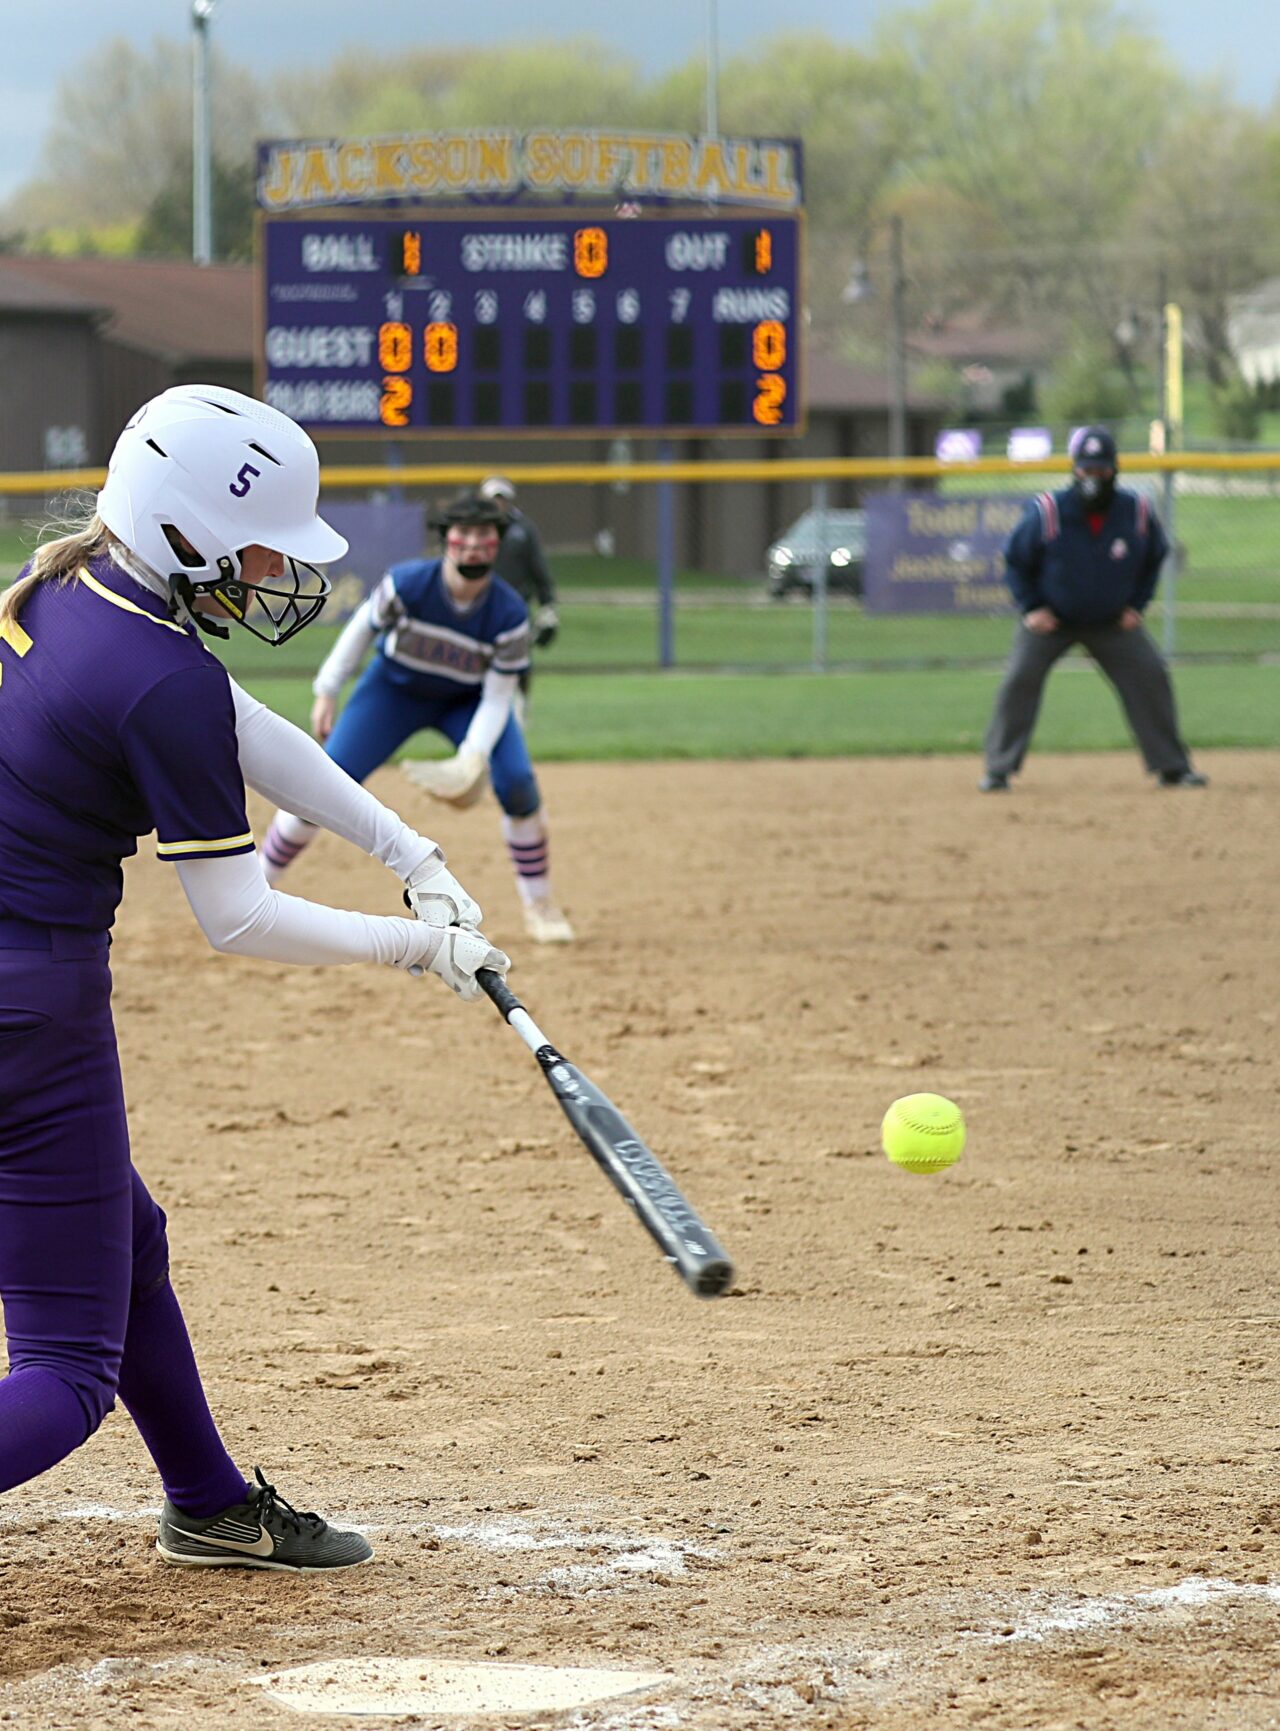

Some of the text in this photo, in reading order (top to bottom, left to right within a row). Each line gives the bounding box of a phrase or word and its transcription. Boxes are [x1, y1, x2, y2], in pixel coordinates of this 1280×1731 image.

[261, 130, 797, 208] JACKSON SOFTBALL
[302, 227, 771, 278] BALL 1 STRIKE 0 OUT 1
[383, 289, 403, 322] 1
[428, 289, 452, 322] 2
[474, 289, 498, 324] 3
[524, 289, 546, 323] 4
[572, 289, 596, 323] 5
[617, 289, 640, 323] 6
[668, 289, 691, 323] 7
[712, 287, 790, 323] RUNS
[266, 320, 786, 372] GUEST 0 0 0
[379, 375, 413, 426] 2
[752, 373, 786, 425] 2
[229, 462, 260, 498] 5
